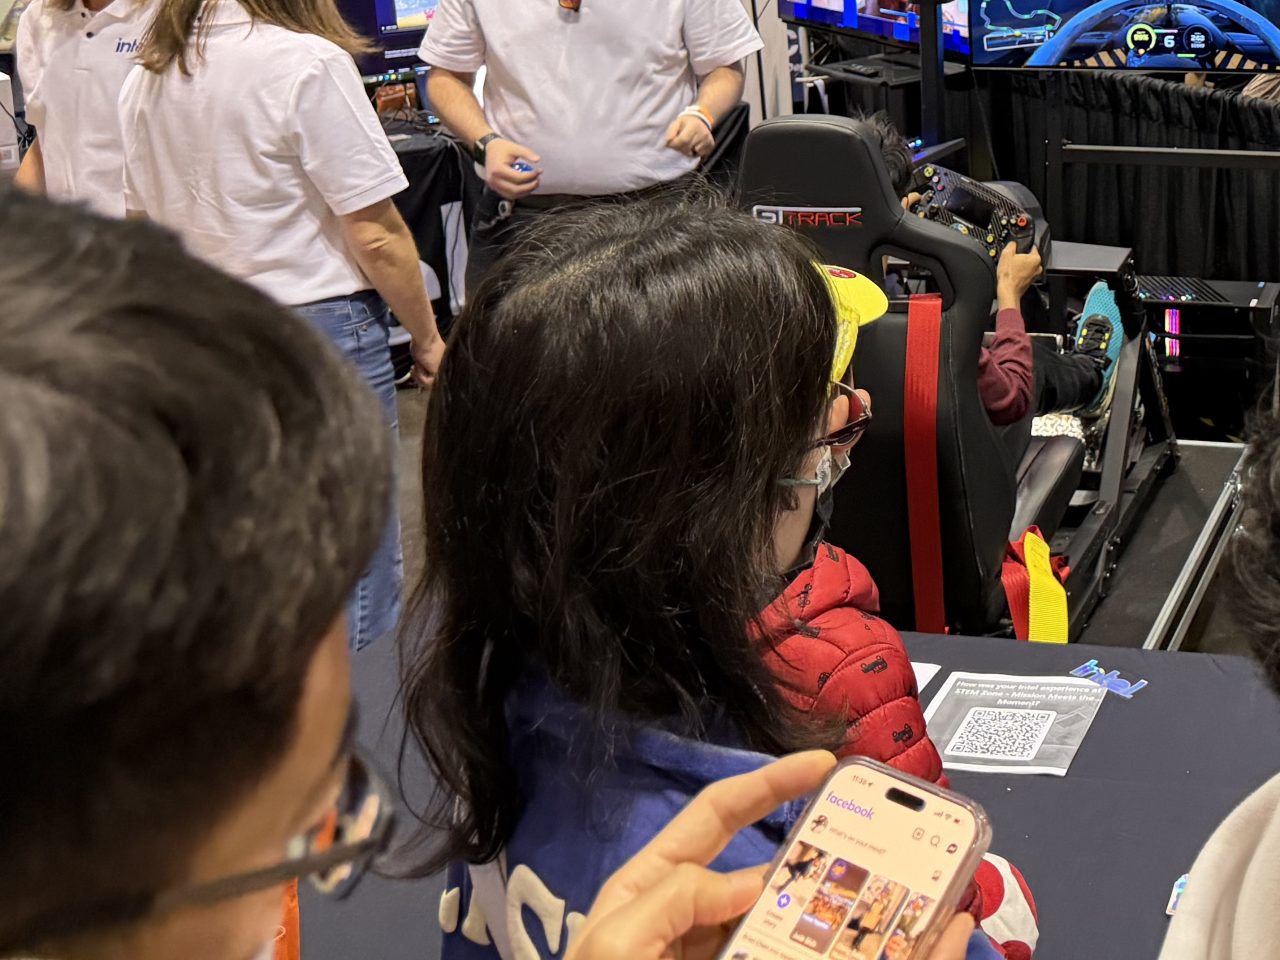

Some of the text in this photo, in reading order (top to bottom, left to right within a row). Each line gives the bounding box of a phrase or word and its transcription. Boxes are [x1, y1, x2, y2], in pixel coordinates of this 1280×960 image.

[1163, 35, 1175, 48] 6
[955, 688, 980, 696] STEM
[1011, 691, 1045, 699] Mission
[1048, 693, 1076, 701] Meets
[997, 698, 1040, 707] Moment?
[826, 790, 875, 820] facebook
